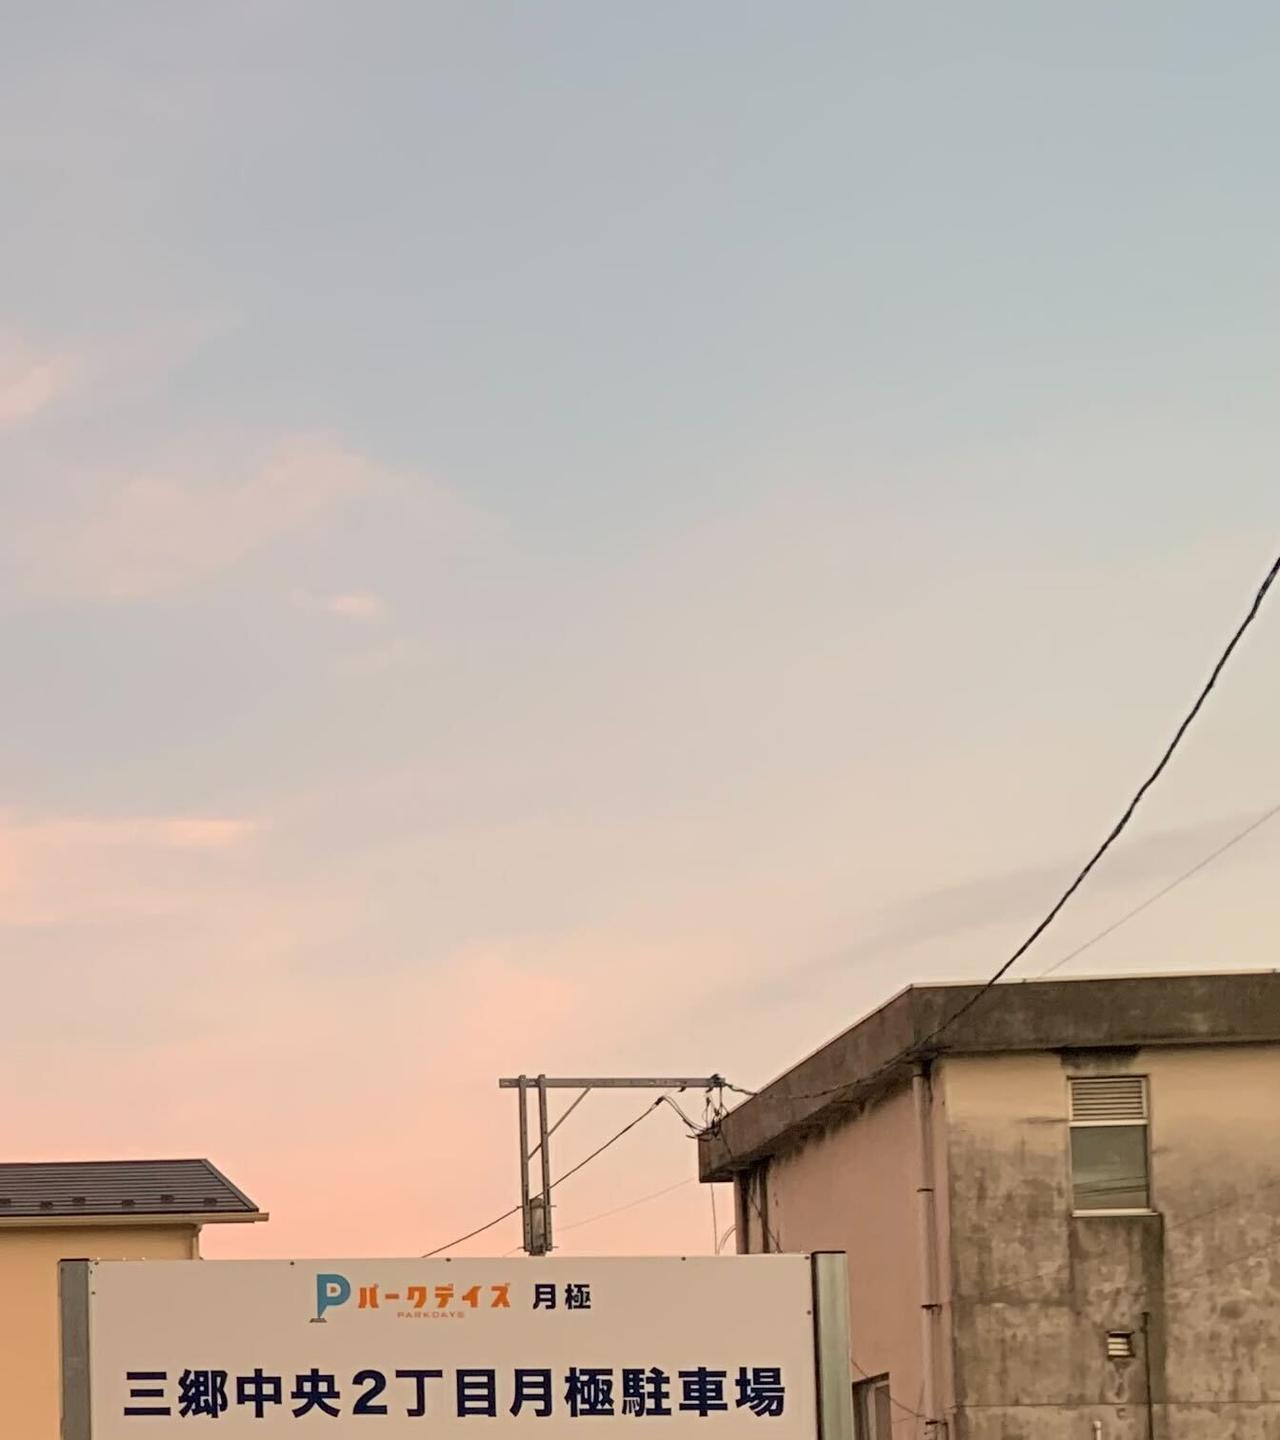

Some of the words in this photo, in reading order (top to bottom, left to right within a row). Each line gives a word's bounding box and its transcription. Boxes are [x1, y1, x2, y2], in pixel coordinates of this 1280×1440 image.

[358, 1282, 511, 1309] パークデイズ
[532, 1283, 591, 1310] 月極
[397, 1311, 465, 1319] PARKDAYS
[123, 1366, 786, 1418] 三郷中央2丁目月極駐車場
